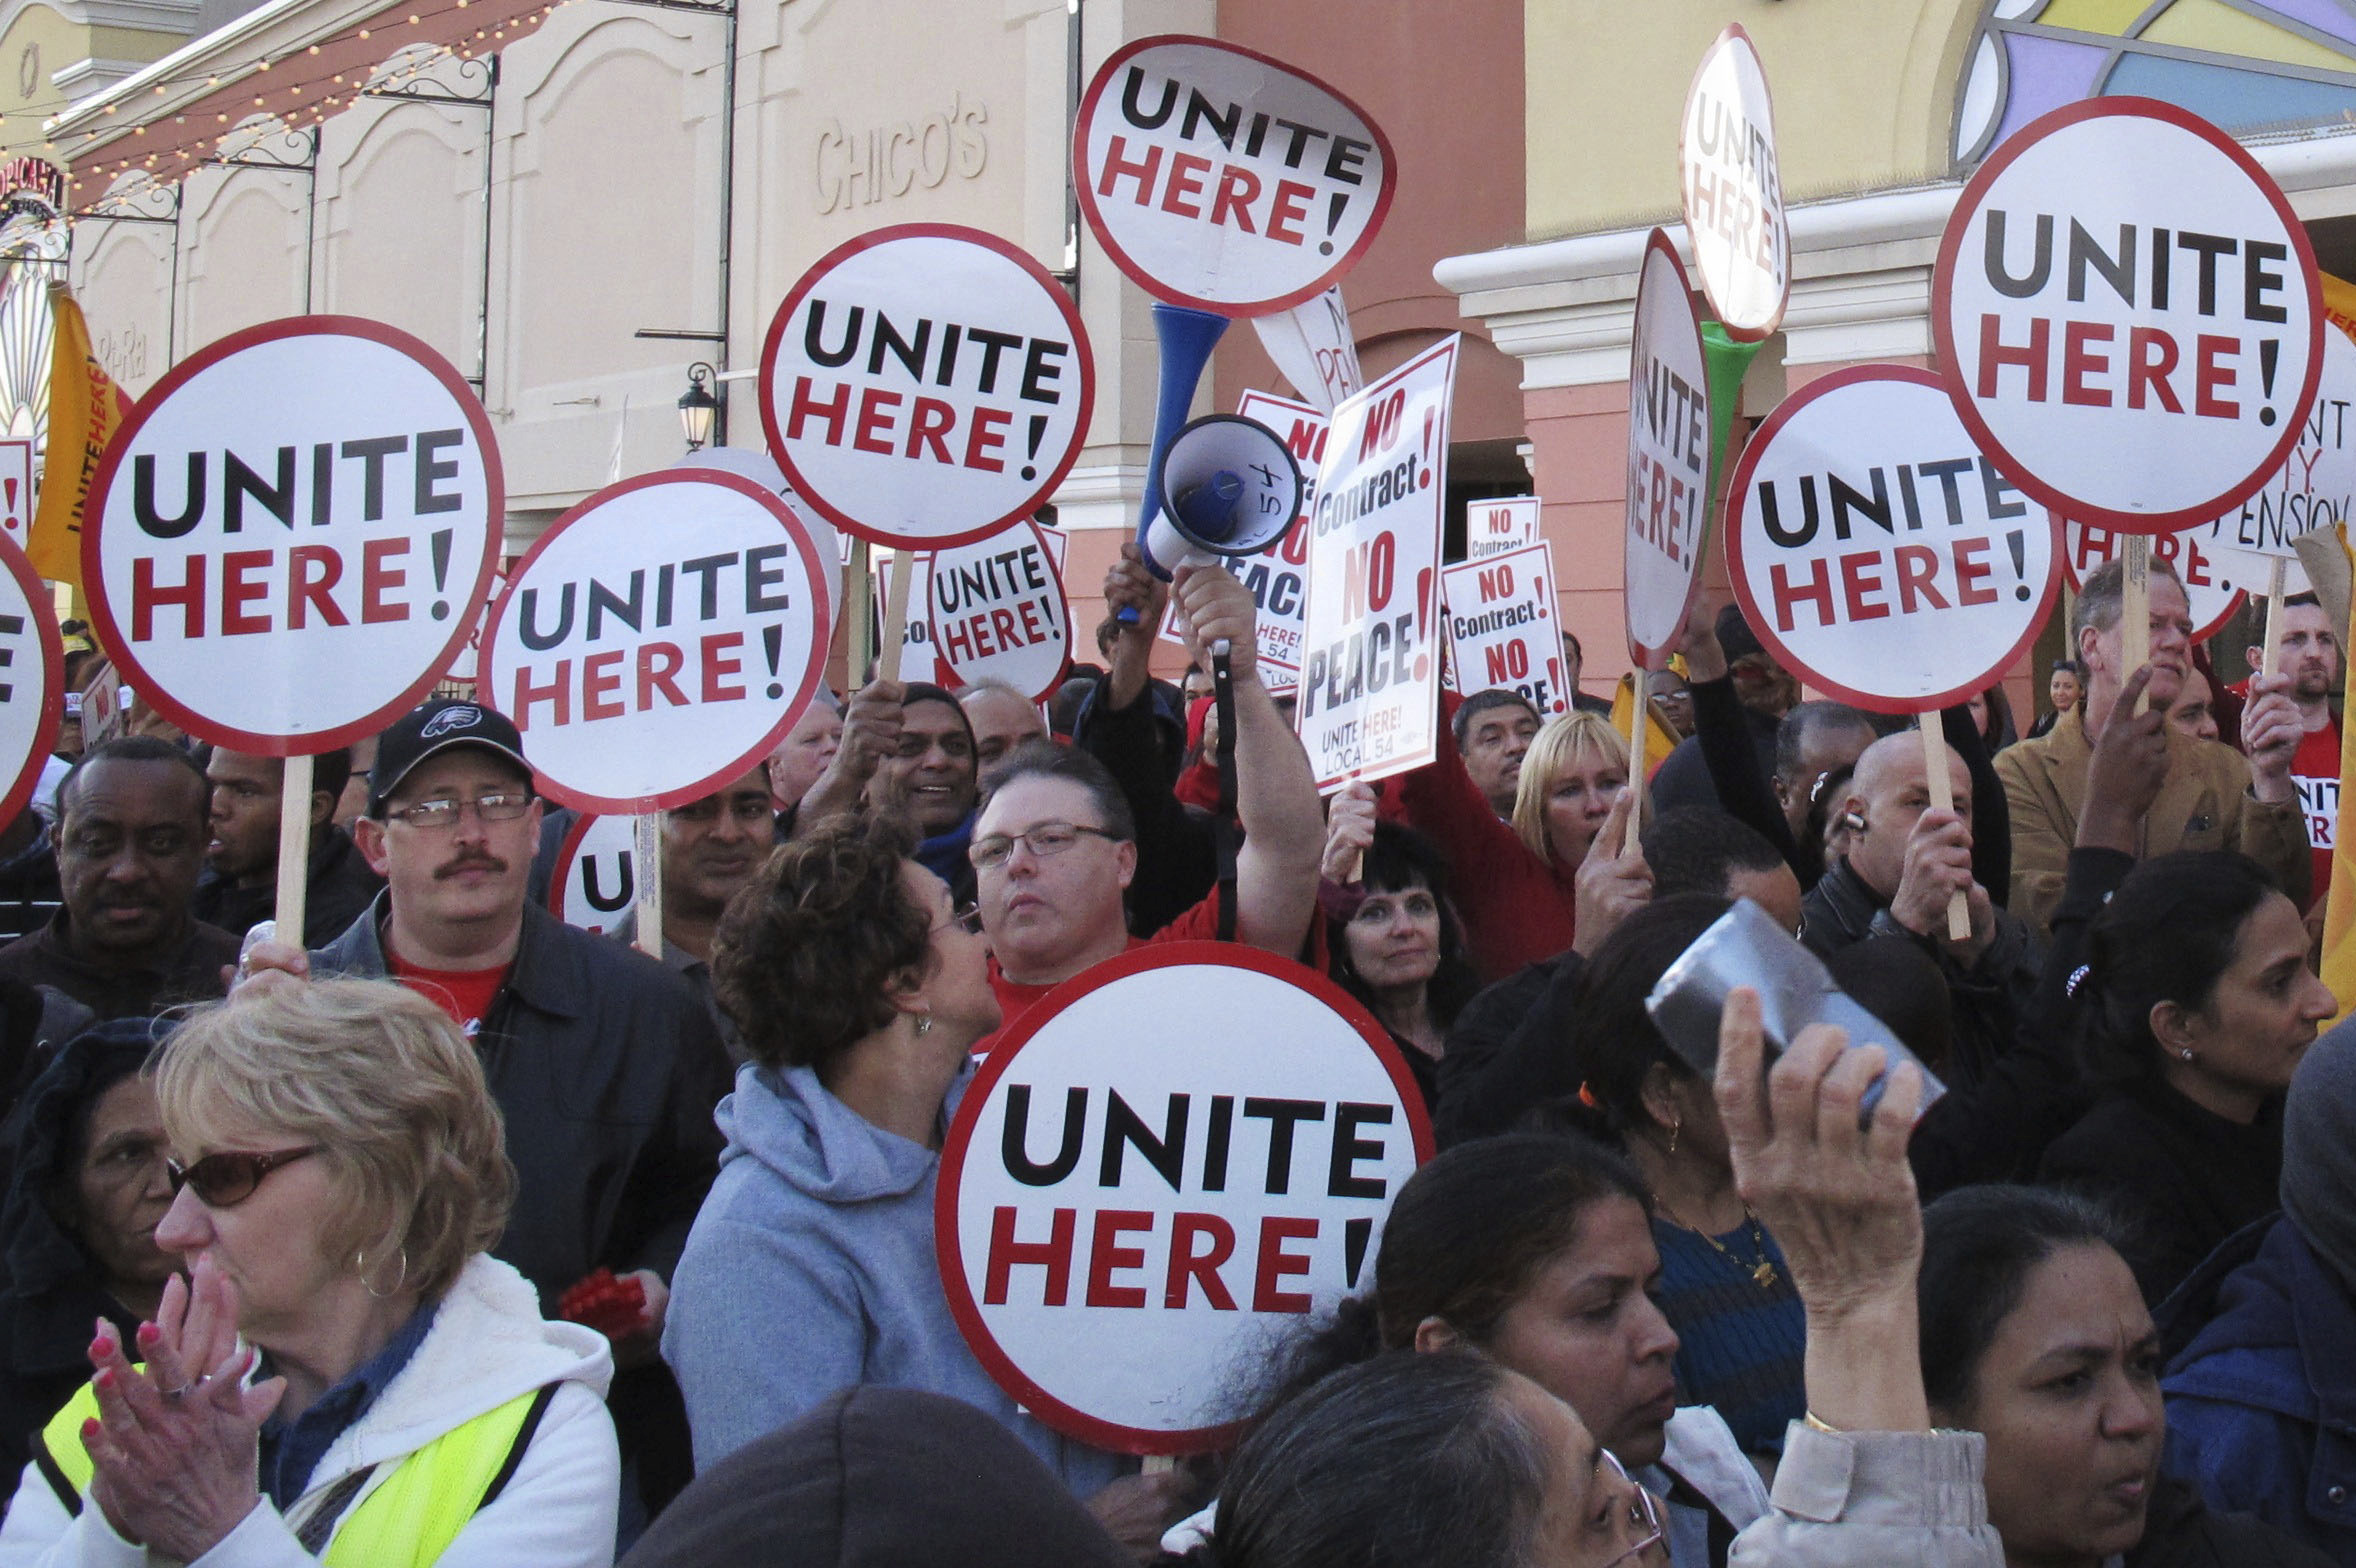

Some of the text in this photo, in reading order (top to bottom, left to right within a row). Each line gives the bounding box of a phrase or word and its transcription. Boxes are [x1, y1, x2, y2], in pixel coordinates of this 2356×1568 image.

[814, 90, 988, 216] CHICO'S
[1121, 65, 1372, 186] UNITE
[1697, 91, 1779, 213] UNITE
[1097, 134, 1350, 256] HERE!
[1692, 162, 1782, 286] HERE!
[1984, 209, 2288, 324] UNITE
[805, 298, 1069, 405] UNITE
[1977, 313, 2280, 427] HERE!
[787, 375, 1049, 481] HERE!
[1358, 388, 1406, 465] NO
[134, 428, 464, 540] UNITE
[1488, 509, 1512, 534] NO
[1758, 455, 2027, 548] UNITE
[132, 528, 454, 643] HERE!
[519, 543, 790, 651] UNITE
[936, 544, 1046, 614] UNITE
[944, 595, 1062, 666] HERE!
[1342, 530, 1395, 626] NO
[1478, 564, 1515, 604] NO
[1769, 528, 2031, 633] HERE!
[513, 623, 784, 732] HERE!
[1267, 644, 1289, 661] 54
[1484, 638, 1529, 685] NO
[1322, 719, 1359, 754] UNITE
[1362, 704, 1402, 739] HERE!
[1325, 744, 1372, 777] LOCAL
[1374, 733, 1394, 760] 54
[1001, 1084, 1394, 1200] UNITE
[983, 1205, 1372, 1315] HERE!
